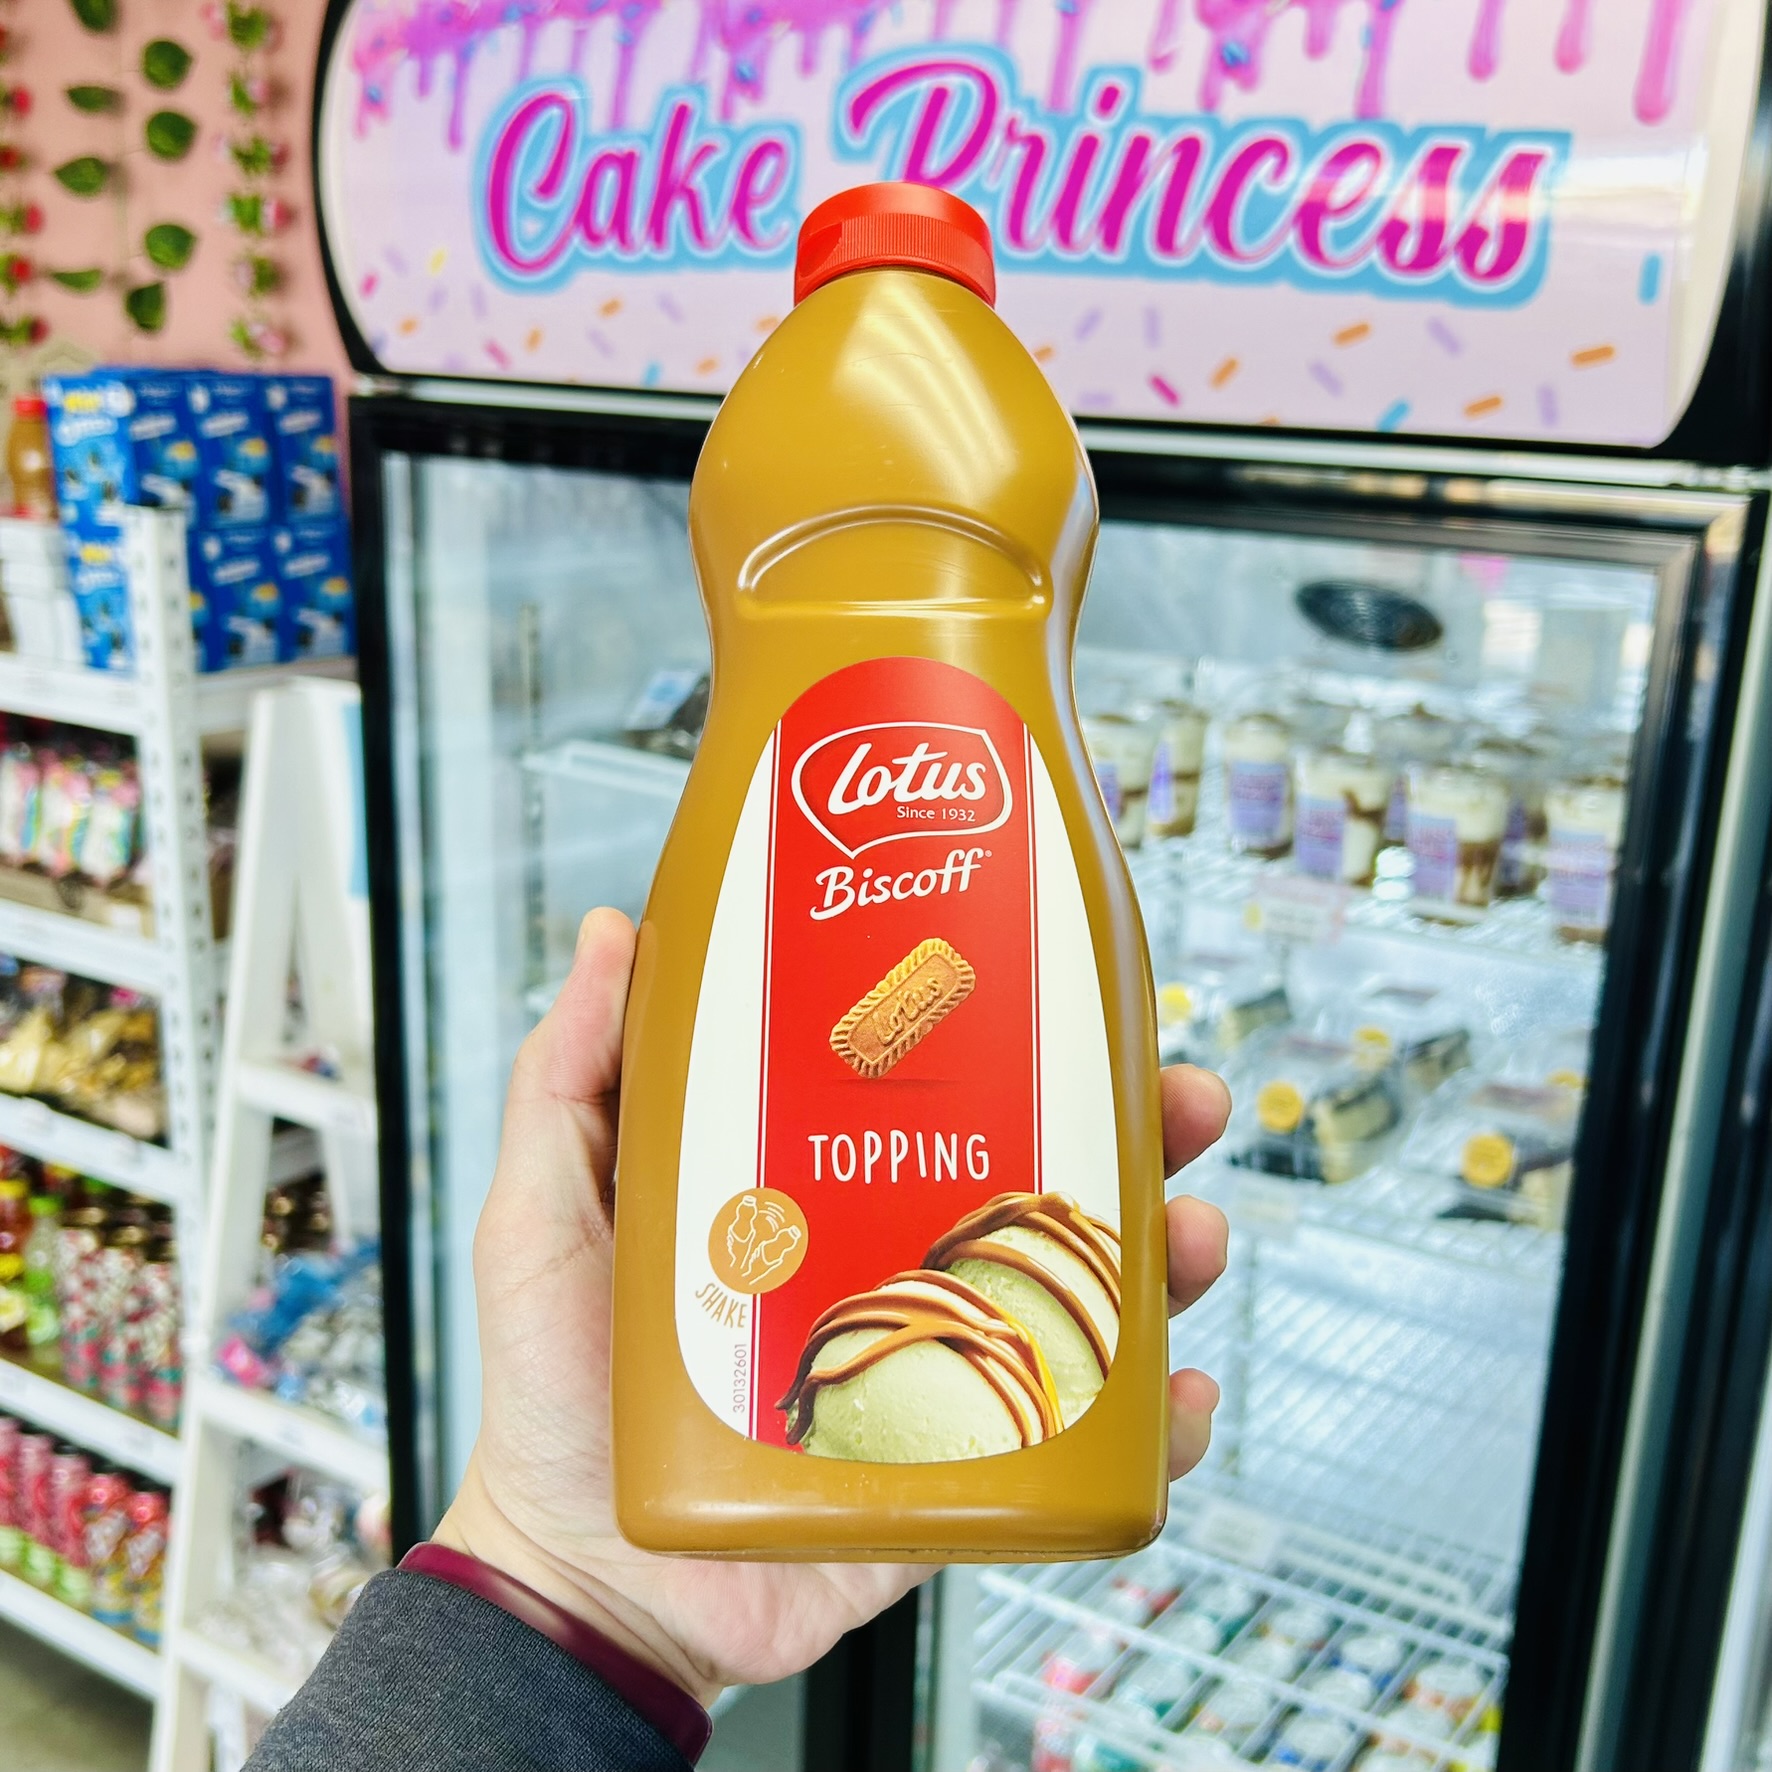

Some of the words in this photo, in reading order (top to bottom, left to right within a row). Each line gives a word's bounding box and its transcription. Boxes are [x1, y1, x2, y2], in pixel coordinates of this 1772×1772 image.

[486, 92, 790, 272] Cake
[849, 60, 1547, 281] Princess
[827, 742, 986, 815] Lotus
[896, 805, 935, 820] Since
[942, 807, 976, 822] 1932
[807, 1129, 990, 1184] TOPPING
[695, 1282, 748, 1329] SHAKE
[732, 1343, 747, 1413] 30132601
